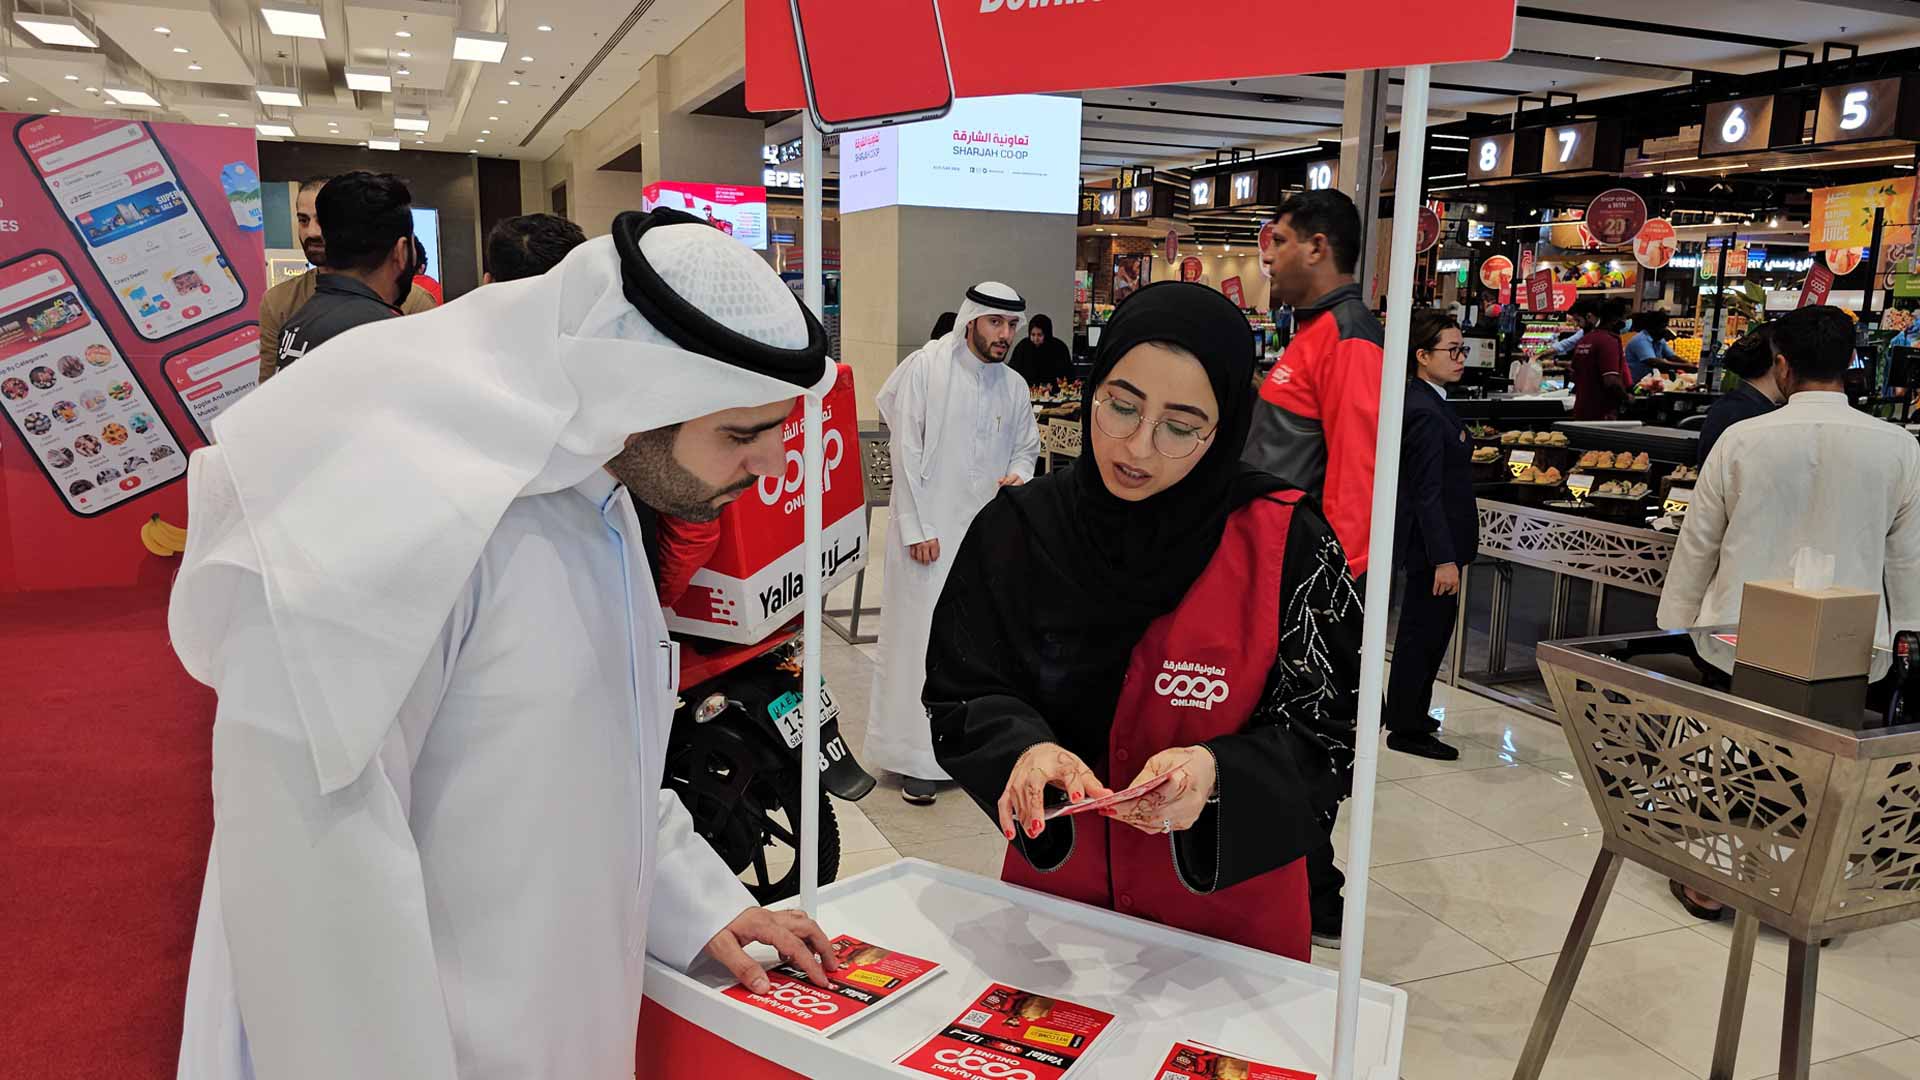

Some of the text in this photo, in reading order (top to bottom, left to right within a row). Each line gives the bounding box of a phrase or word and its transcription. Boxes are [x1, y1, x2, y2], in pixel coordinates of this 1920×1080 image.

[1840, 90, 1869, 130] 5
[1721, 106, 1746, 143] 6
[952, 130, 1029, 146] تعاونية الشارقة
[1558, 131, 1576, 162] 7
[952, 145, 1029, 160] SHARJAH CO-OP
[1479, 142, 1497, 172] 8
[763, 169, 804, 188] EPE
[1235, 175, 1251, 200] 11
[1309, 165, 1331, 190] 10
[1101, 193, 1116, 215] 14
[1134, 190, 1148, 212] 13
[1193, 183, 1208, 205] 12
[1604, 218, 1626, 235] 20
[1170, 699, 1206, 710] ONLINE
[826, 736, 847, 762] 07
[974, 1049, 1021, 1066] ONLINE
[1025, 1049, 1065, 1066] Yalla!
